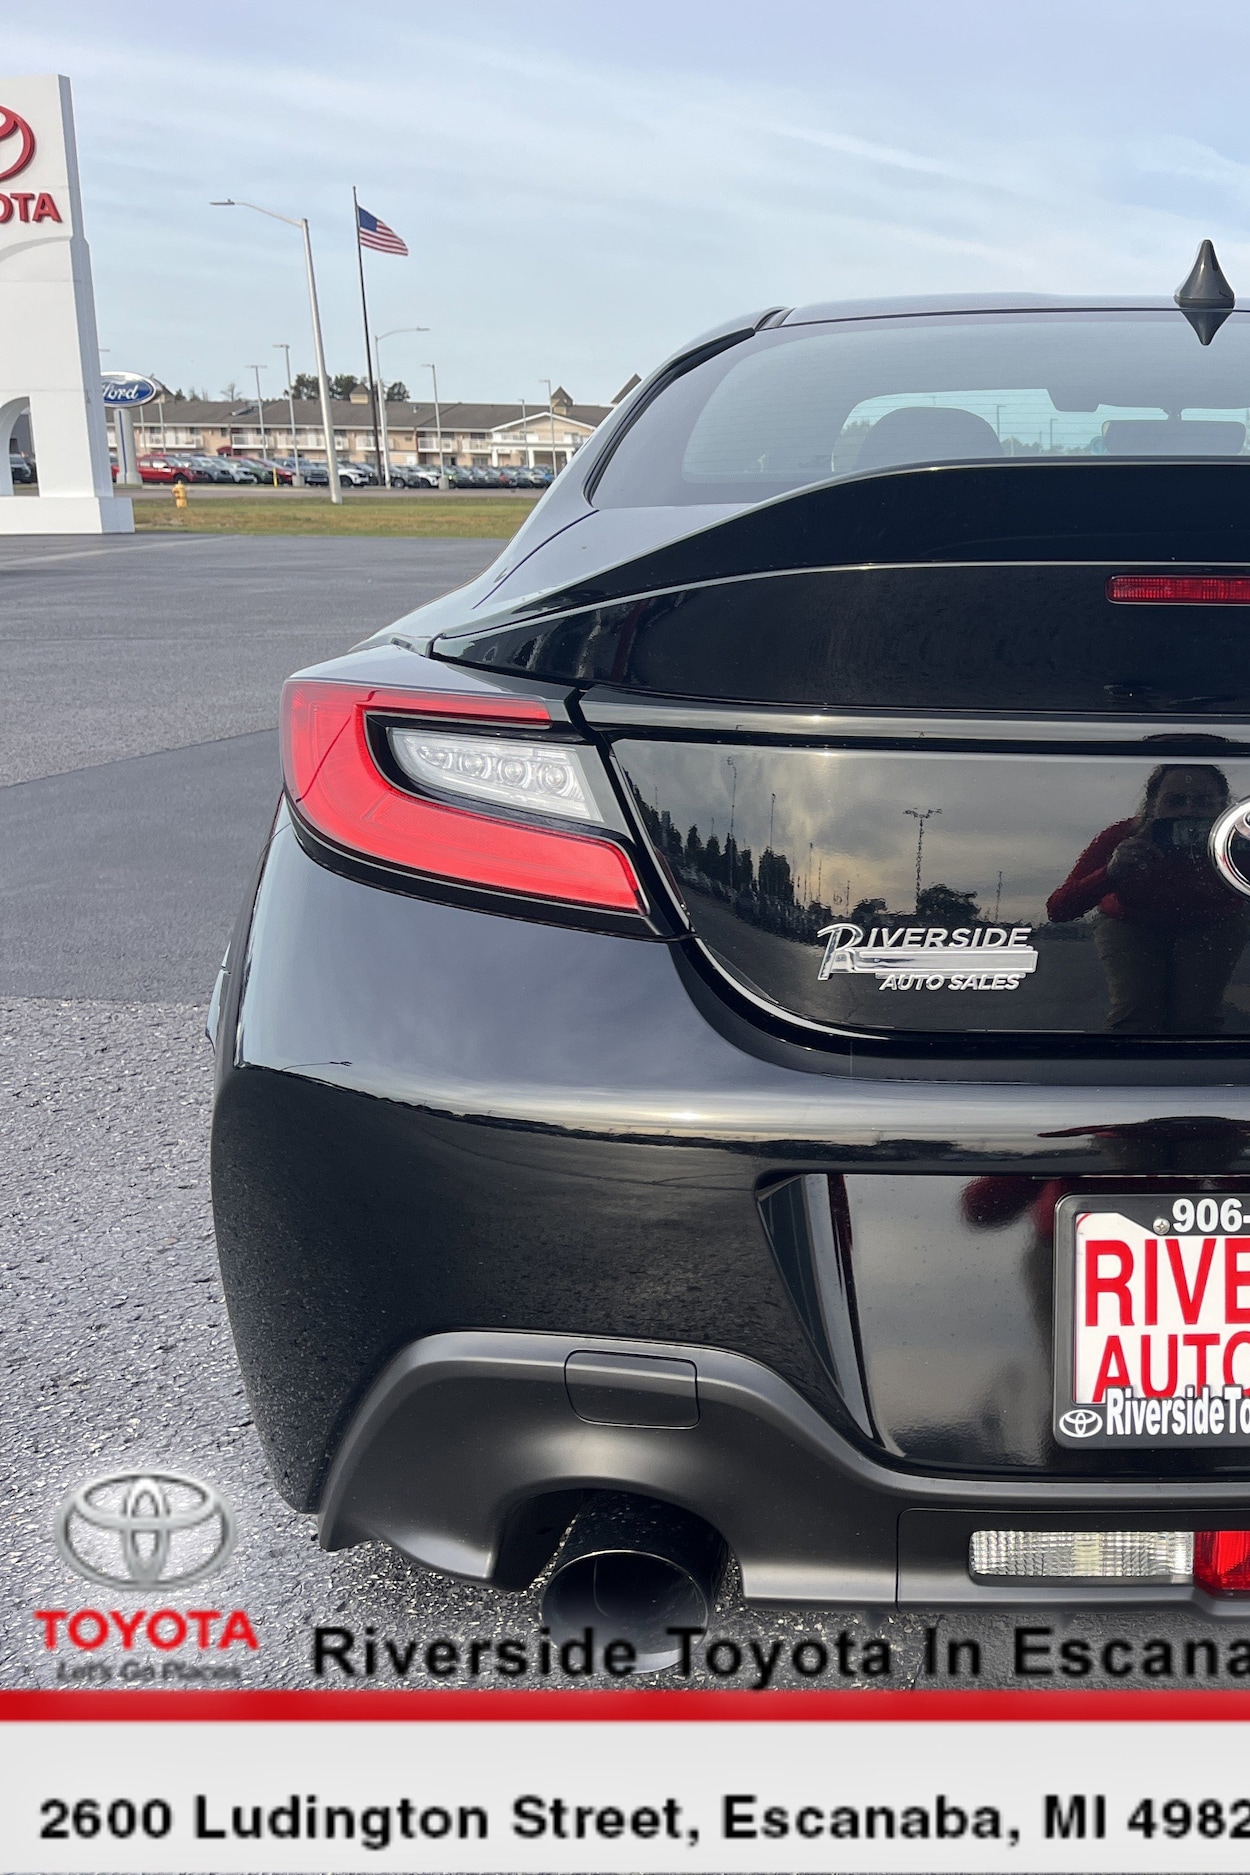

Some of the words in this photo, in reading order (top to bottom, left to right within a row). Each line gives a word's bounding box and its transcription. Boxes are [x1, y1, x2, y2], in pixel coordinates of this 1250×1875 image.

[817, 923, 1032, 981] RIVERSIDE
[879, 974, 944, 991] AUTO
[948, 973, 1021, 991] SALES
